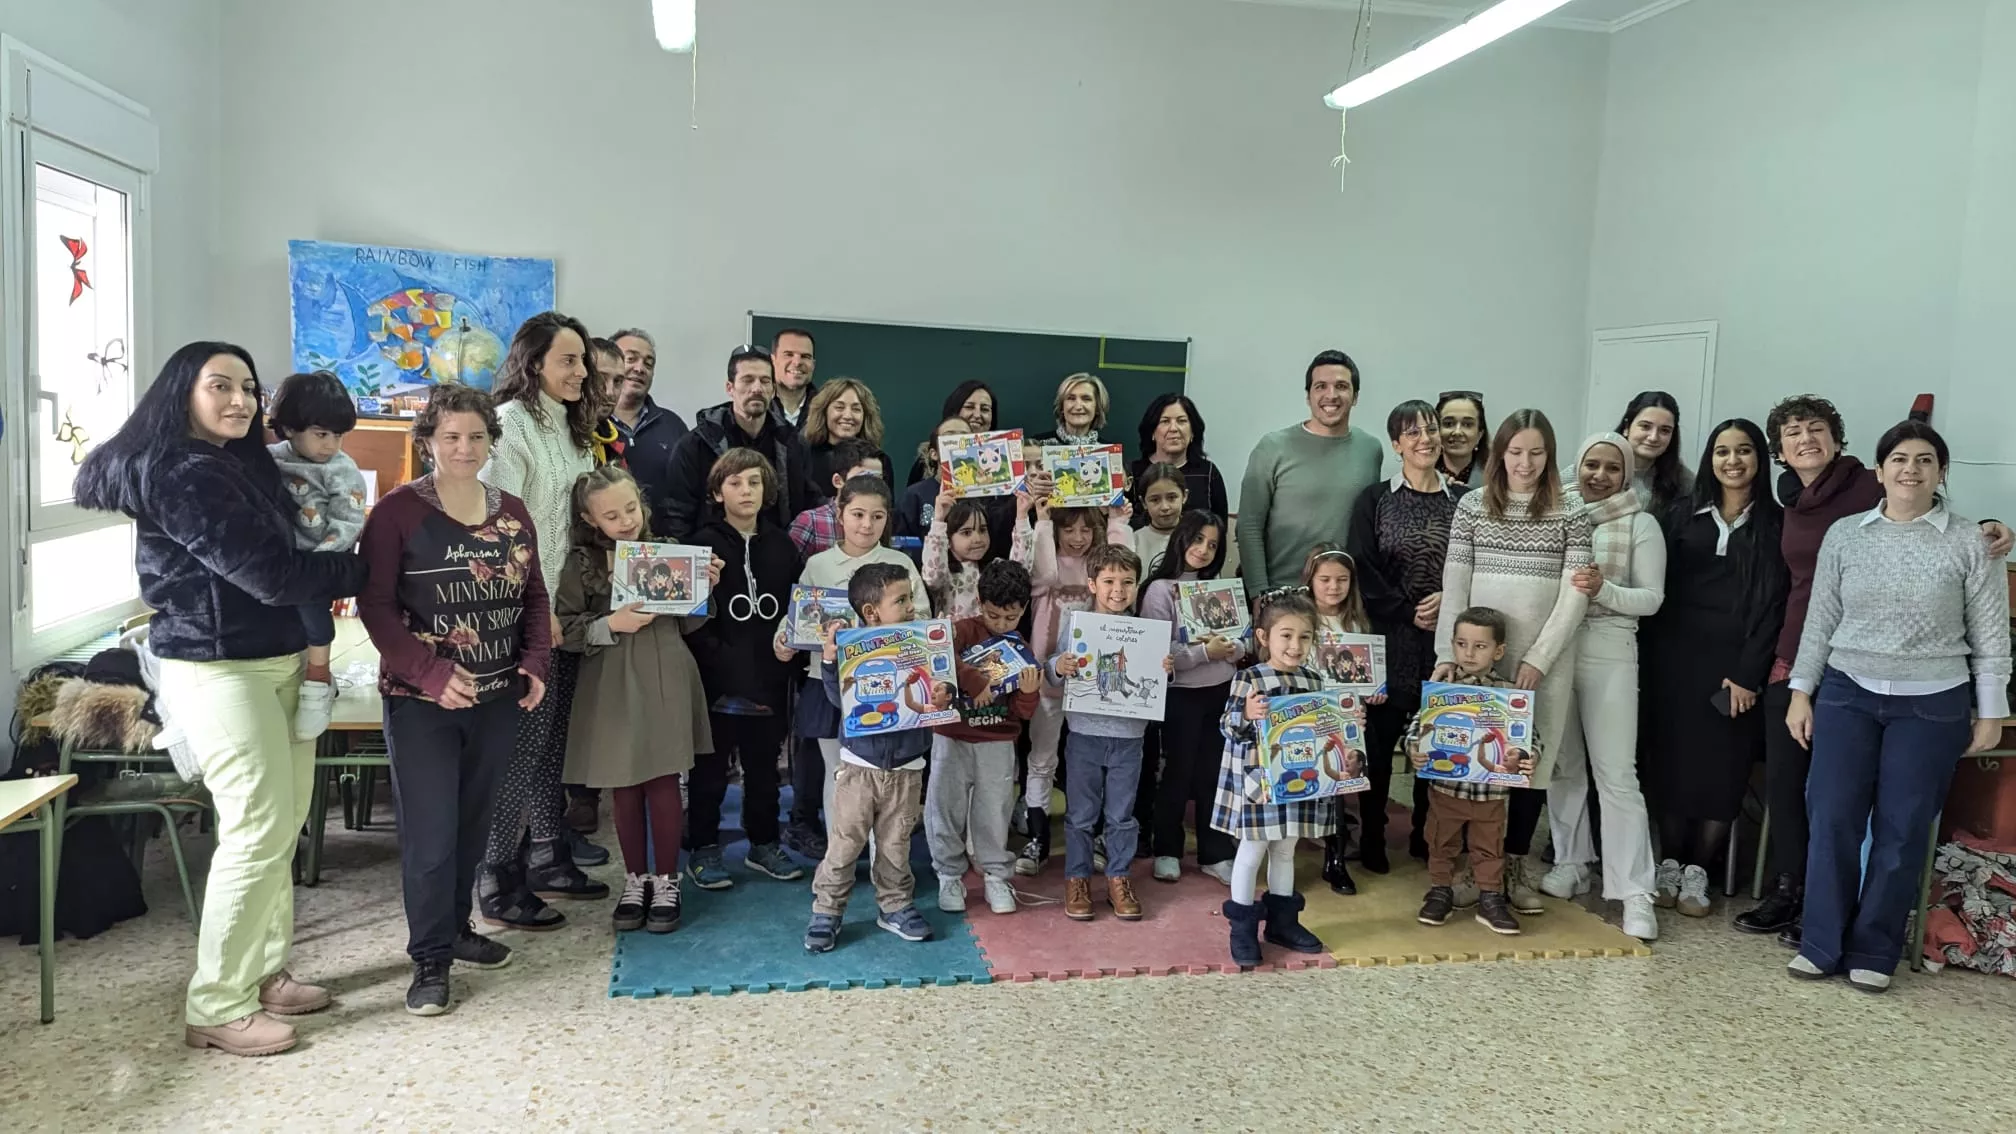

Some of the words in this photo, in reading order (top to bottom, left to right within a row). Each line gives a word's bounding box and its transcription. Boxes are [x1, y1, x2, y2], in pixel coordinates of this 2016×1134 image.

[355, 247, 436, 270] RAINBOW
[454, 257, 488, 272] FISH
[444, 543, 501, 562] Aphorisms
[433, 614, 448, 635] IS
[455, 612, 484, 632] MY
[487, 606, 525, 631] SPIRIT
